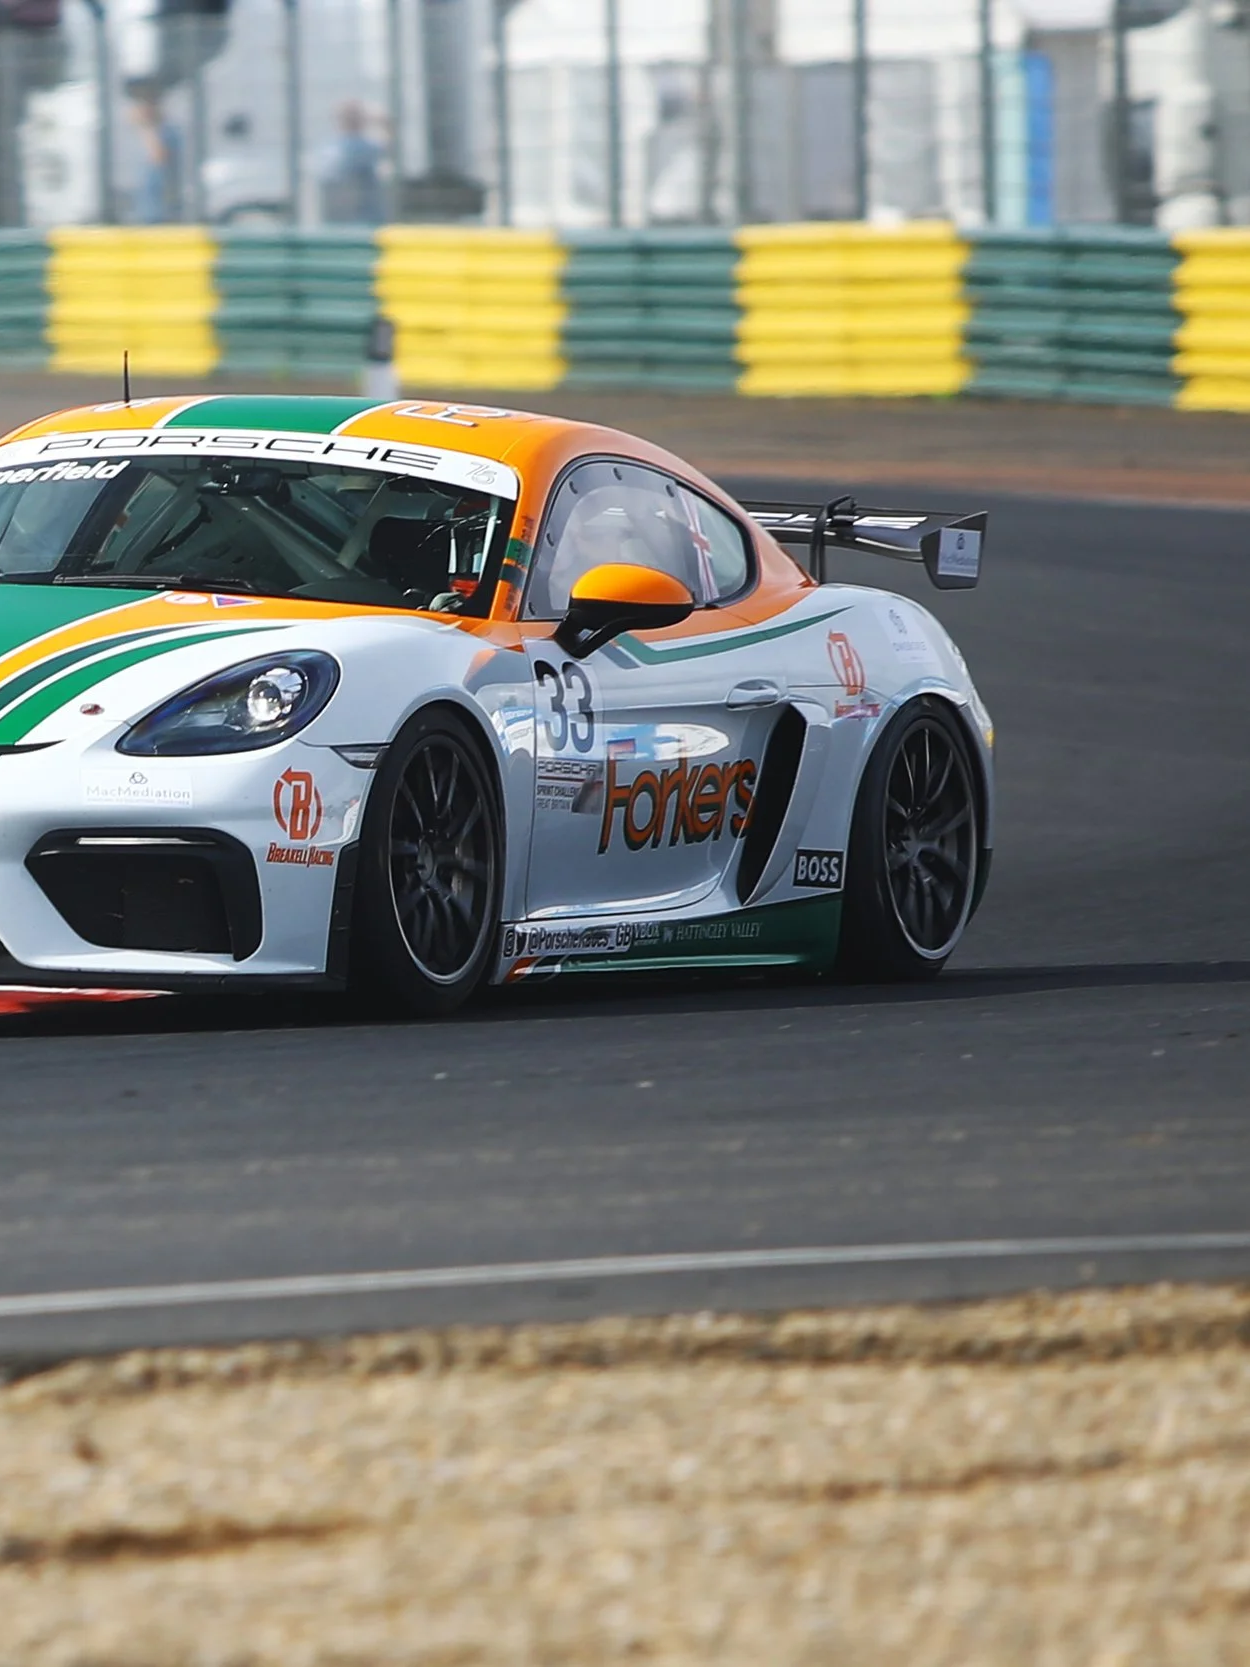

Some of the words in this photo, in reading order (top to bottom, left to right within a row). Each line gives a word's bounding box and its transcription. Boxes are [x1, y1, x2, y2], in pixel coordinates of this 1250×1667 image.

[38, 434, 442, 471] PORSCHE
[533, 659, 595, 753] 33
[86, 786, 191, 799] MacMediation
[597, 738, 756, 855] Forkers
[266, 842, 307, 864] BREAKELL
[797, 855, 840, 883] BOSS
